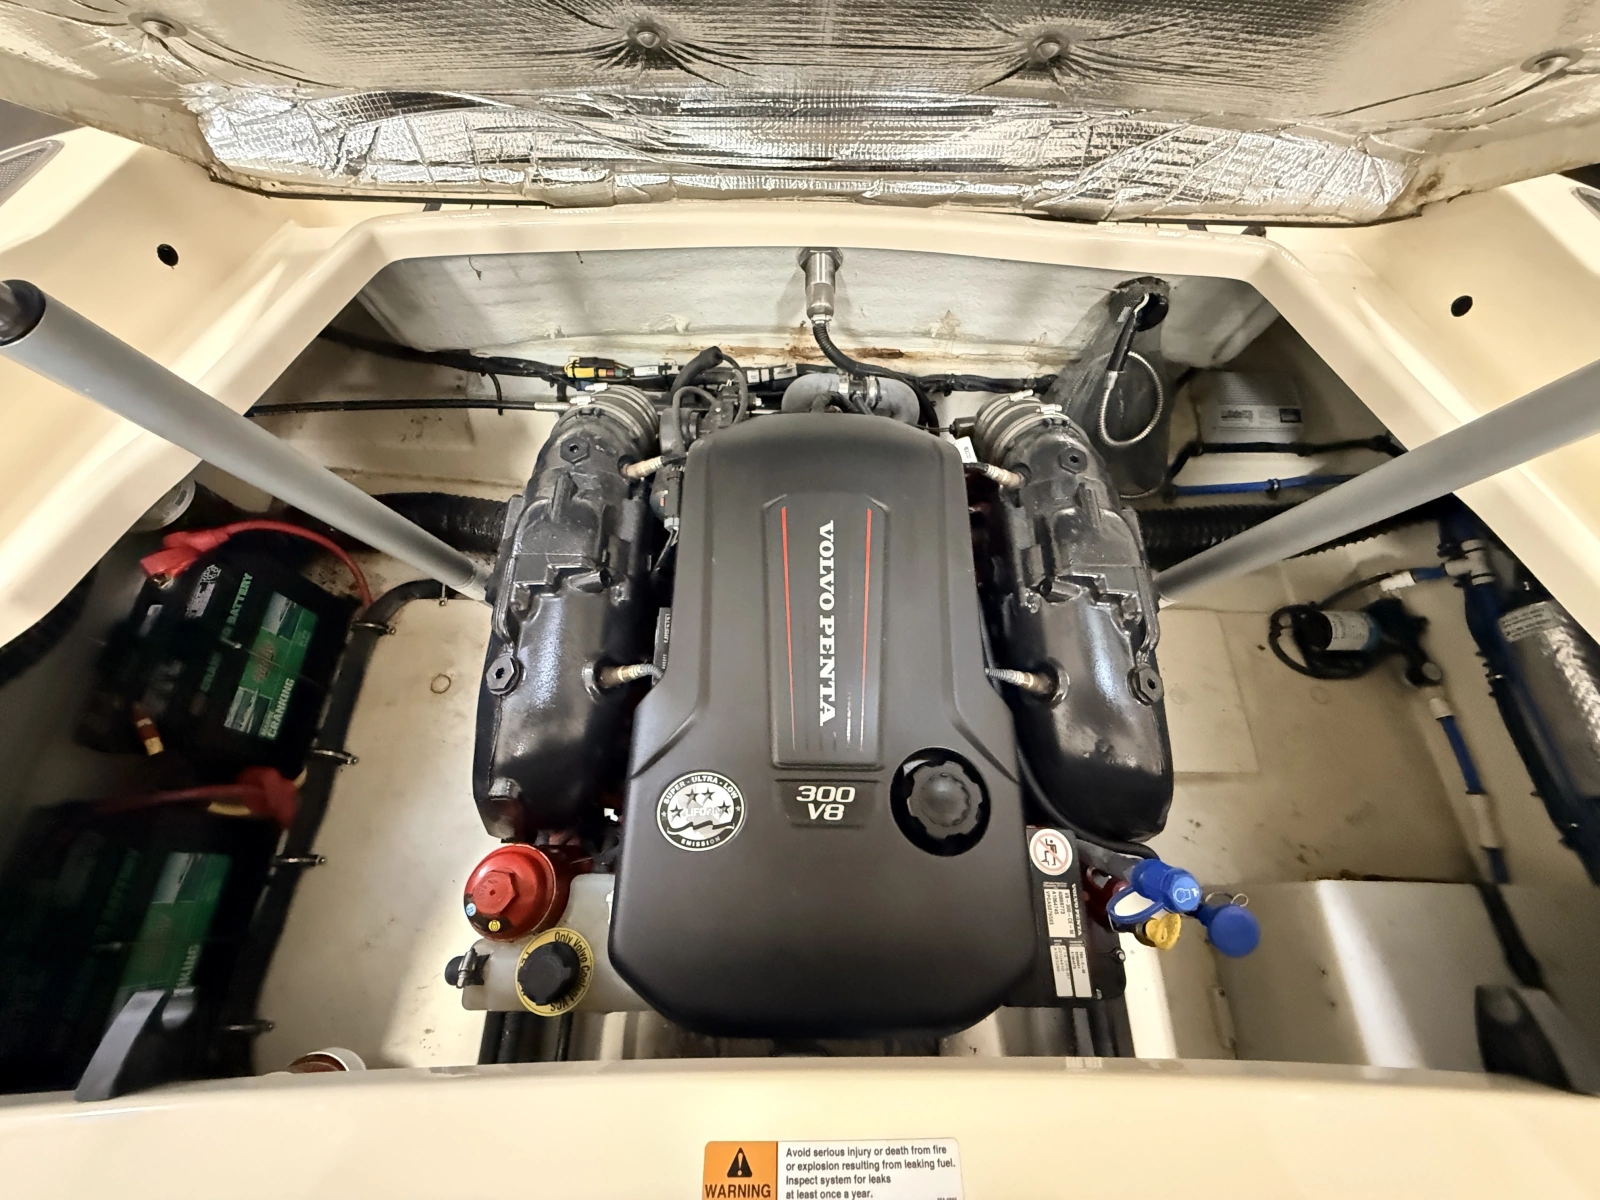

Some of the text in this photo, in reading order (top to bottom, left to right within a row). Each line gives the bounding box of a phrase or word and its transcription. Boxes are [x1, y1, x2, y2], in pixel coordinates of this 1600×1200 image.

[226, 572, 254, 625] BATTERY
[819, 520, 836, 727] VOLVO PENTA
[267, 677, 296, 739] CRANKING
[663, 781, 686, 805] SUPER
[691, 775, 718, 784] ULTRA
[723, 782, 738, 800] LOW
[796, 785, 856, 803] 300
[808, 803, 845, 821] V8
[680, 836, 720, 848] EMISSION
[1071, 883, 1079, 908] VOLVO
[1074, 909, 1082, 936] PENTA
[554, 931, 572, 944] Only
[573, 938, 588, 963] Volvo
[550, 1000, 569, 1012] VCS
[785, 1144, 947, 1158] Avoid serious injury or death from fire
[785, 1158, 956, 1173] or explosion resulting from leaking fuel.
[785, 1174, 892, 1187] Inspect system for leaks
[704, 1183, 771, 1199] WARNING
[785, 1189, 873, 1200] at least once a year.
